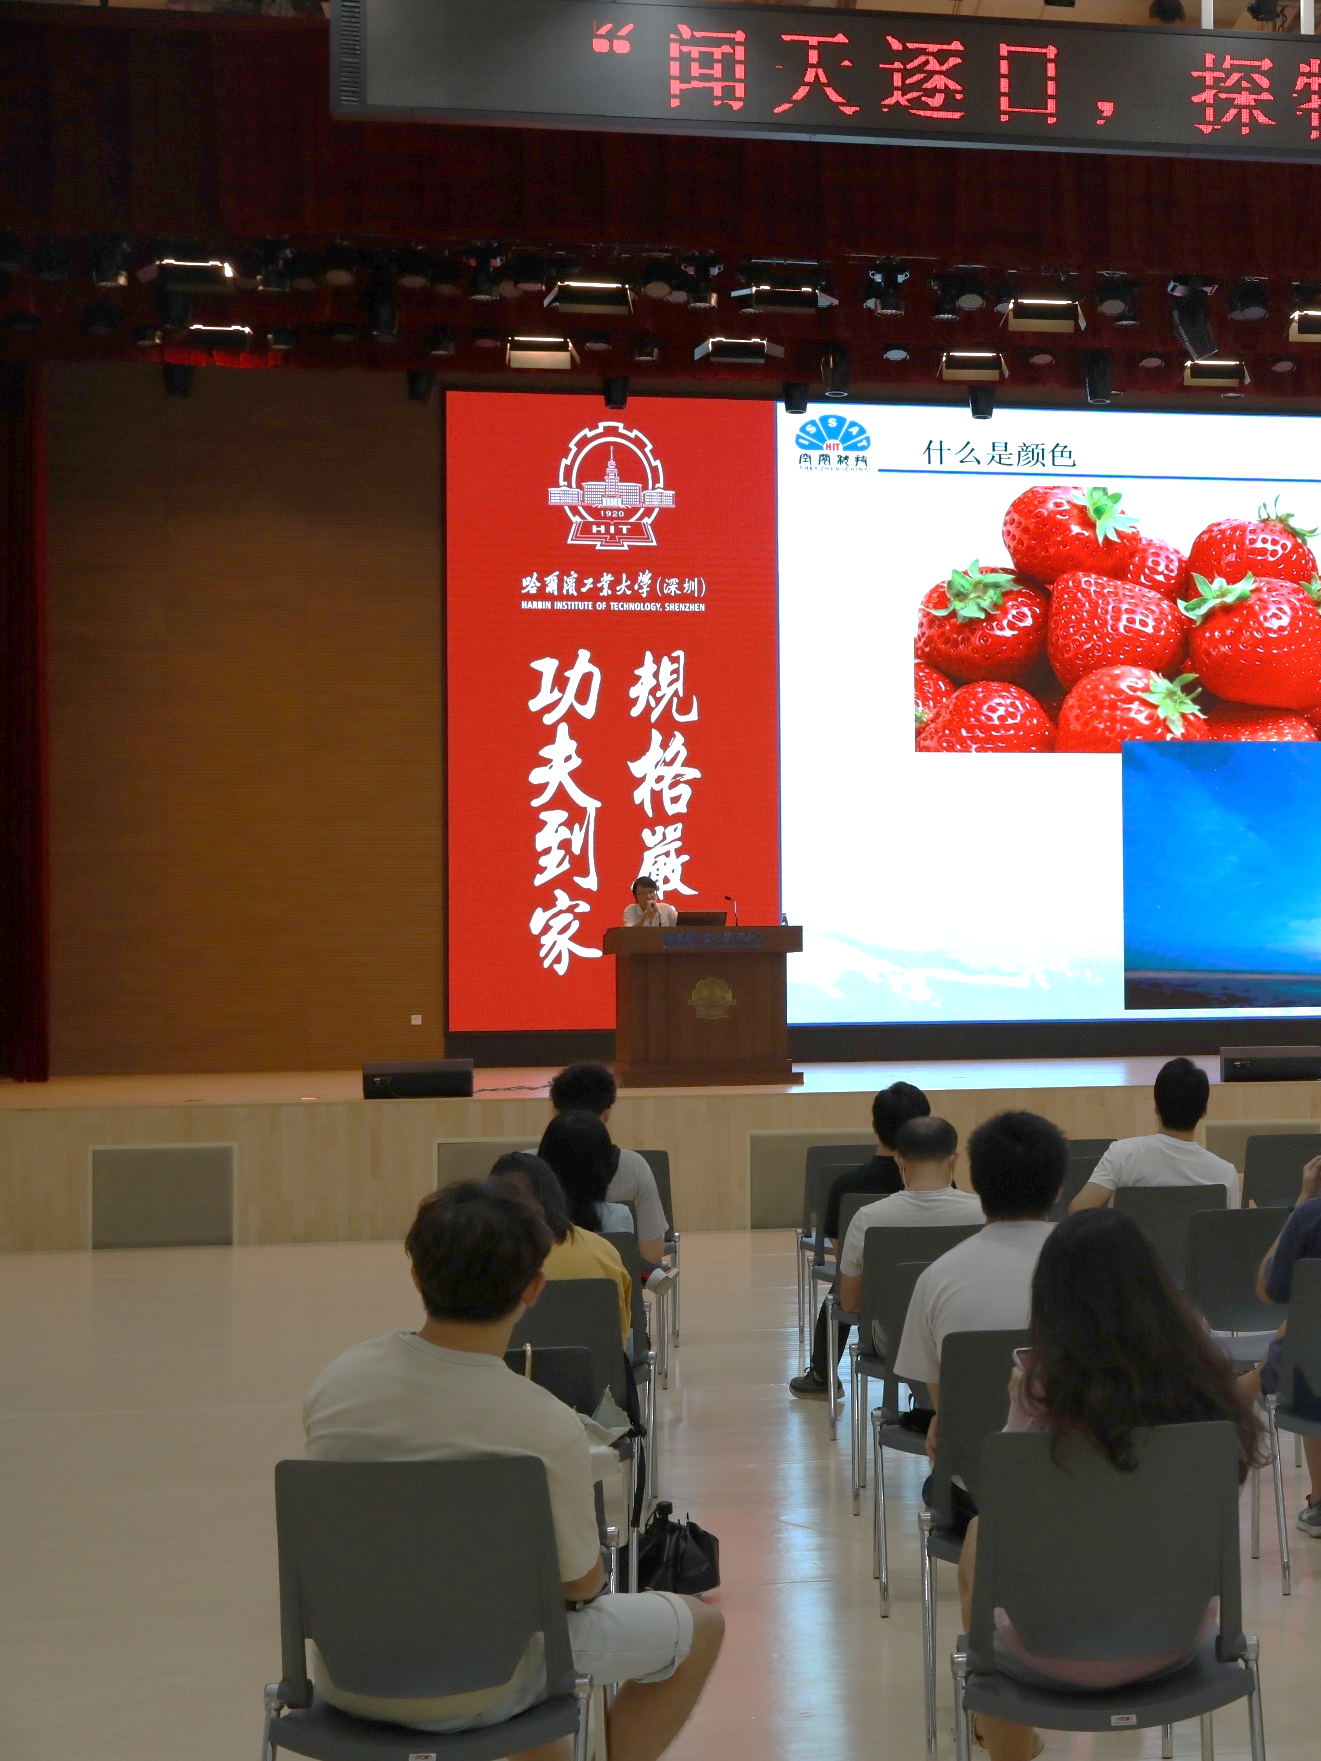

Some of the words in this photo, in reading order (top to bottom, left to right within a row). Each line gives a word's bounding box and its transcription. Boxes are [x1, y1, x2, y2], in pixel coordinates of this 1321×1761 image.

[825, 442, 841, 451] HIT
[922, 439, 1077, 468] 什么是颜色
[600, 510, 625, 518] 1920
[591, 524, 632, 535] HIT
[521, 600, 552, 610] HARBIN
[554, 600, 594, 611] INSTITUTE
[596, 601, 607, 611] OF
[664, 602, 706, 612] SHENZHEN
[627, 649, 702, 908] 規格嚴
[527, 648, 603, 976] 功夫到家
